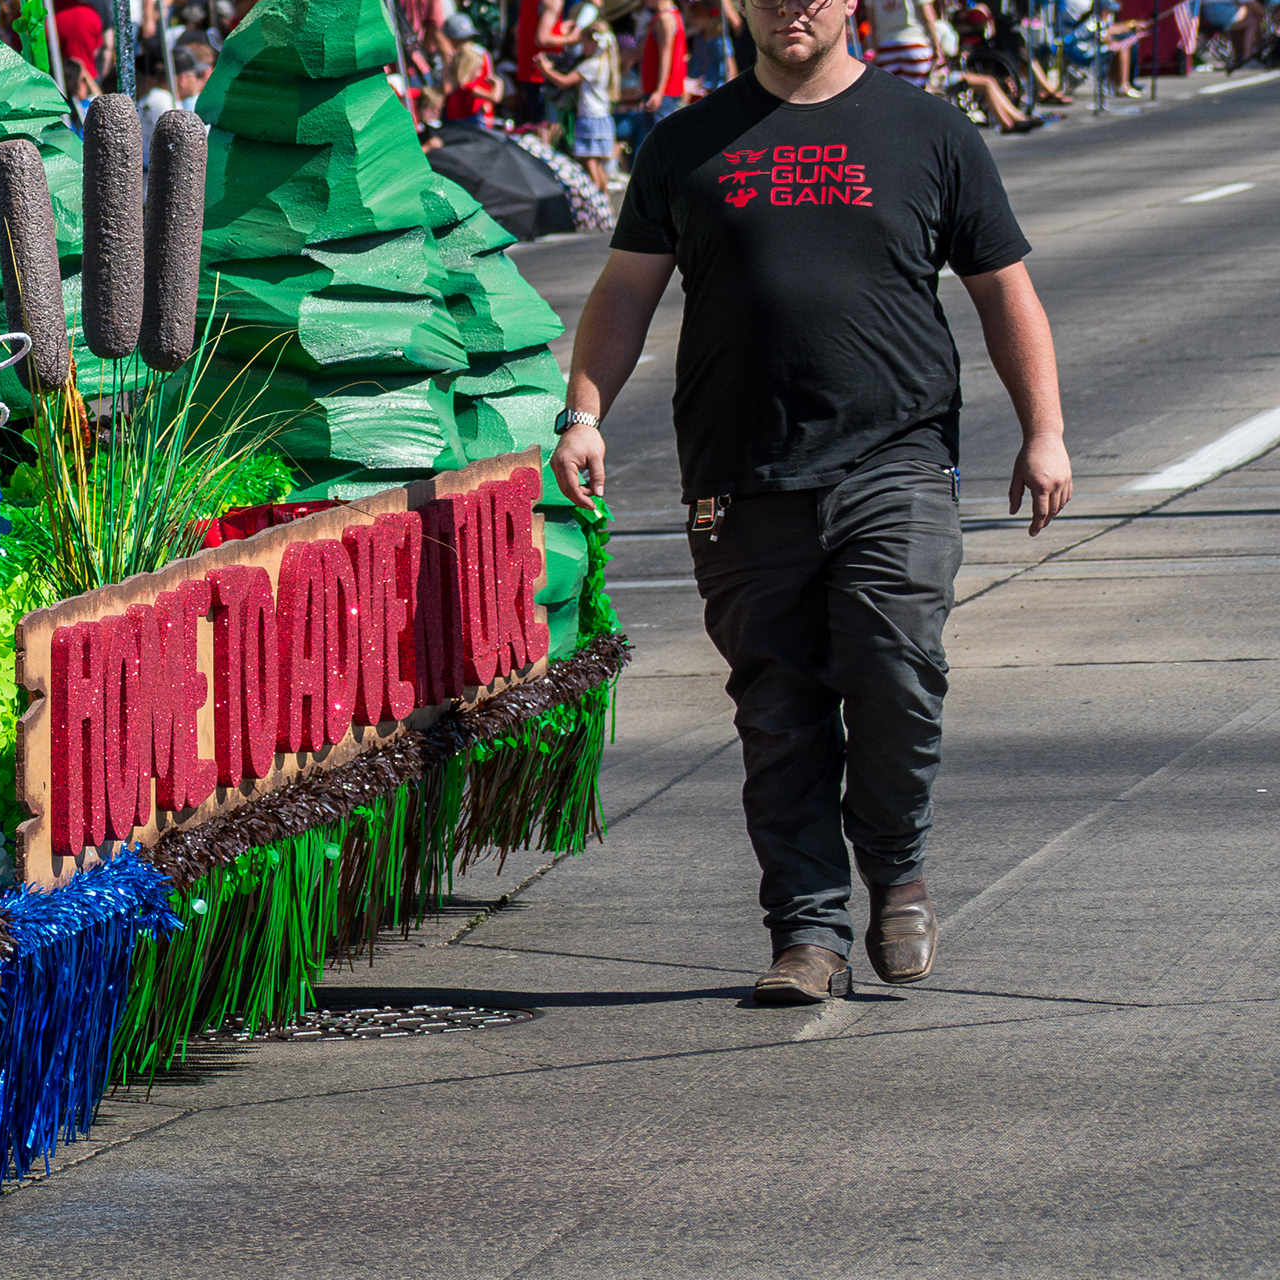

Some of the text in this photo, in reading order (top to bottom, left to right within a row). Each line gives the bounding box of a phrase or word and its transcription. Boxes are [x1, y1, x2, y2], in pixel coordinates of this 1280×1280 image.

[773, 144, 848, 163] GOD
[771, 164, 866, 184] GUNS
[770, 185, 874, 207] GAINZ
[51, 467, 550, 857] HOME TO ADVENTURE
